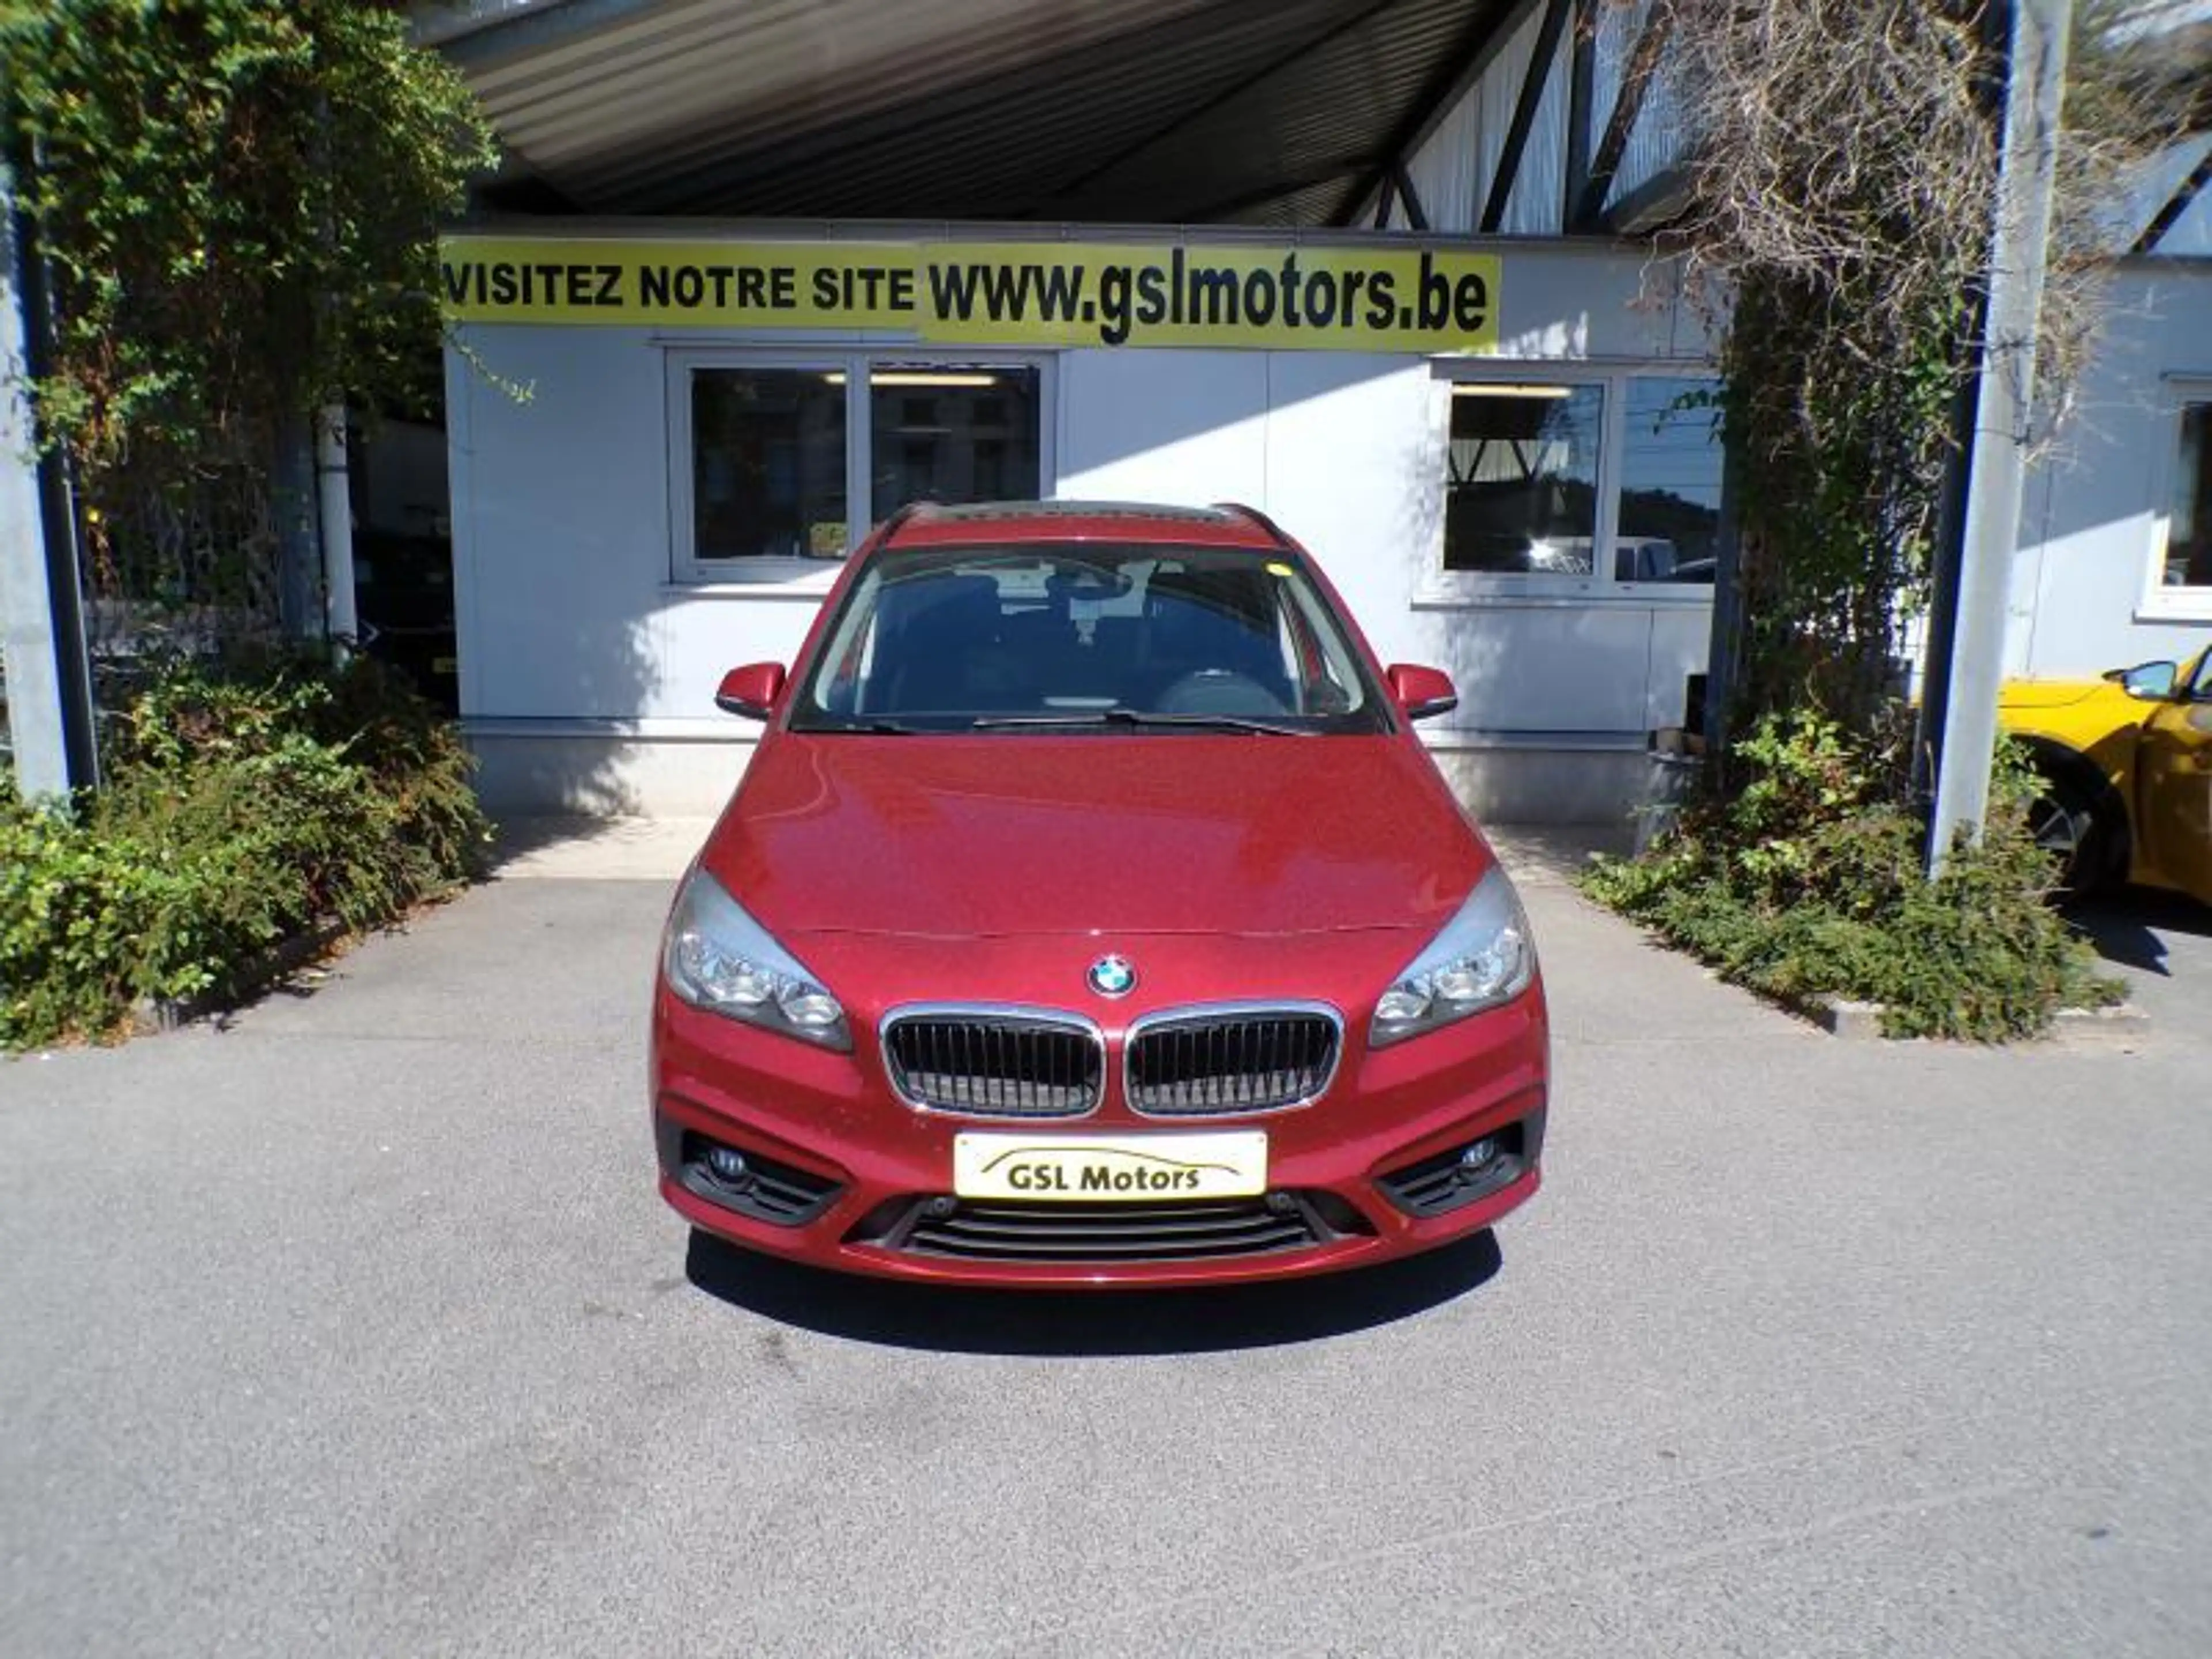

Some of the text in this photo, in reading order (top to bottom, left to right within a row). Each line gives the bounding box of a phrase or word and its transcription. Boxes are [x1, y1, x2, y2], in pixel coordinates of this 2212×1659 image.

[443, 263, 915, 310] VISITEZ NOTRE SITE
[929, 247, 1487, 344] www.gslmotors.be
[1007, 1164, 1200, 1190] GSL Motors
